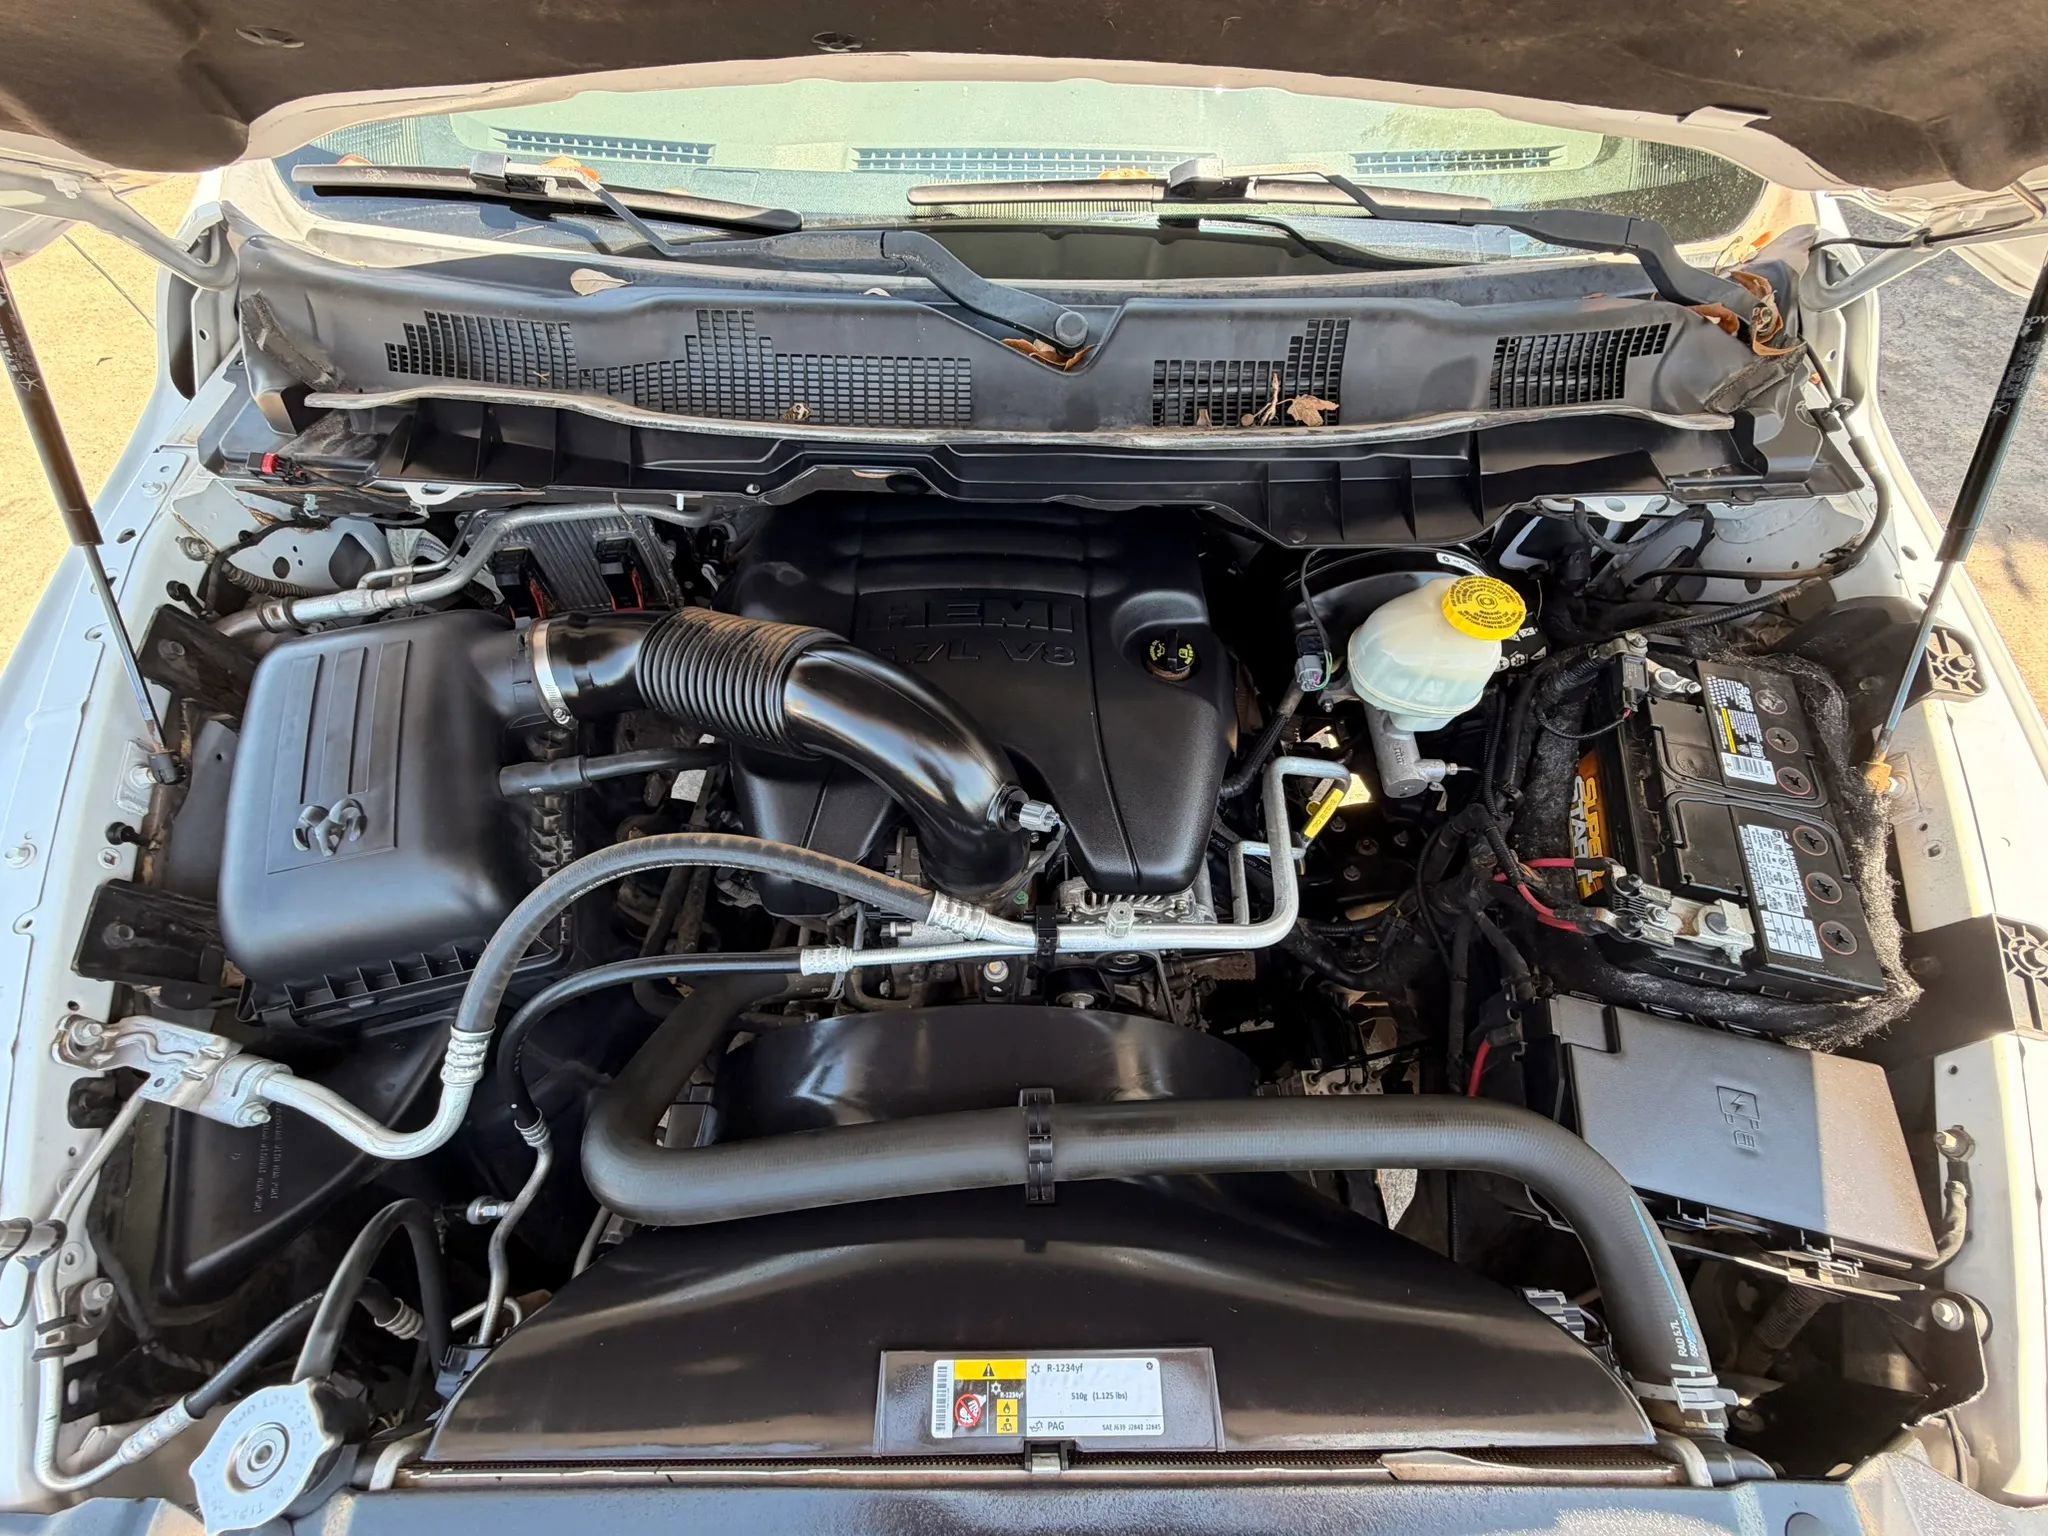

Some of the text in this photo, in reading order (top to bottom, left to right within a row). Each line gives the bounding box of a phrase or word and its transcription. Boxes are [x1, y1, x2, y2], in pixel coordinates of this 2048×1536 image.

[998, 640, 1078, 666] V8
[1047, 1362, 1084, 1375] R-1234yf
[1071, 1390, 1128, 1402] 510g (1.125 lbs)
[1047, 1421, 1065, 1431] PAG
